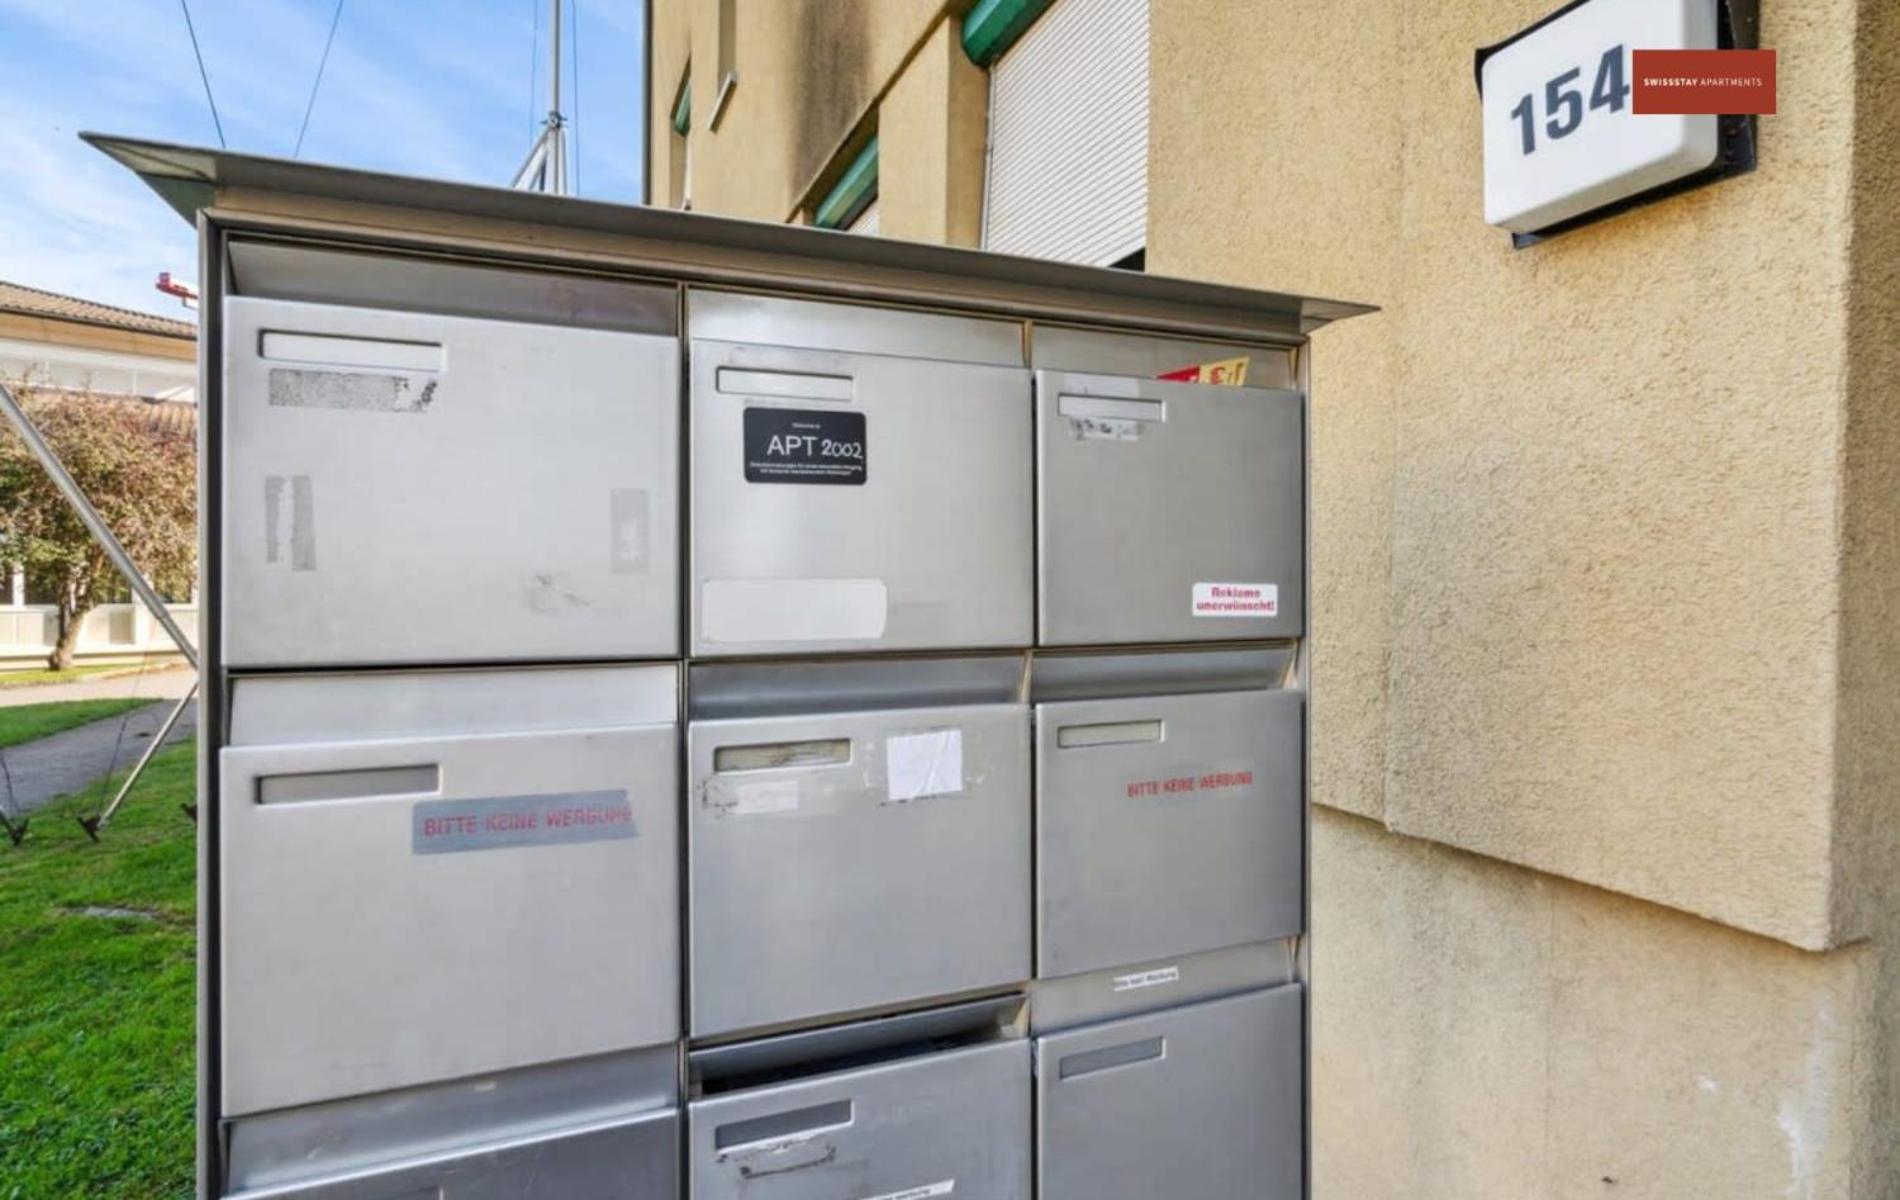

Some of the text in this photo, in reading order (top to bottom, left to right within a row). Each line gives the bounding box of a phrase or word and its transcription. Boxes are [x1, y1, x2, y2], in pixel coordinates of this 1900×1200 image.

[1511, 44, 1630, 155] 154
[766, 434, 864, 460] APT 2002
[1210, 586, 1262, 598] Reklame
[1196, 600, 1275, 611] unerwünscht!
[1127, 771, 1254, 798] BITTE KEINE WERBUNG
[424, 815, 477, 837] BITTE
[485, 811, 537, 832] KEINE
